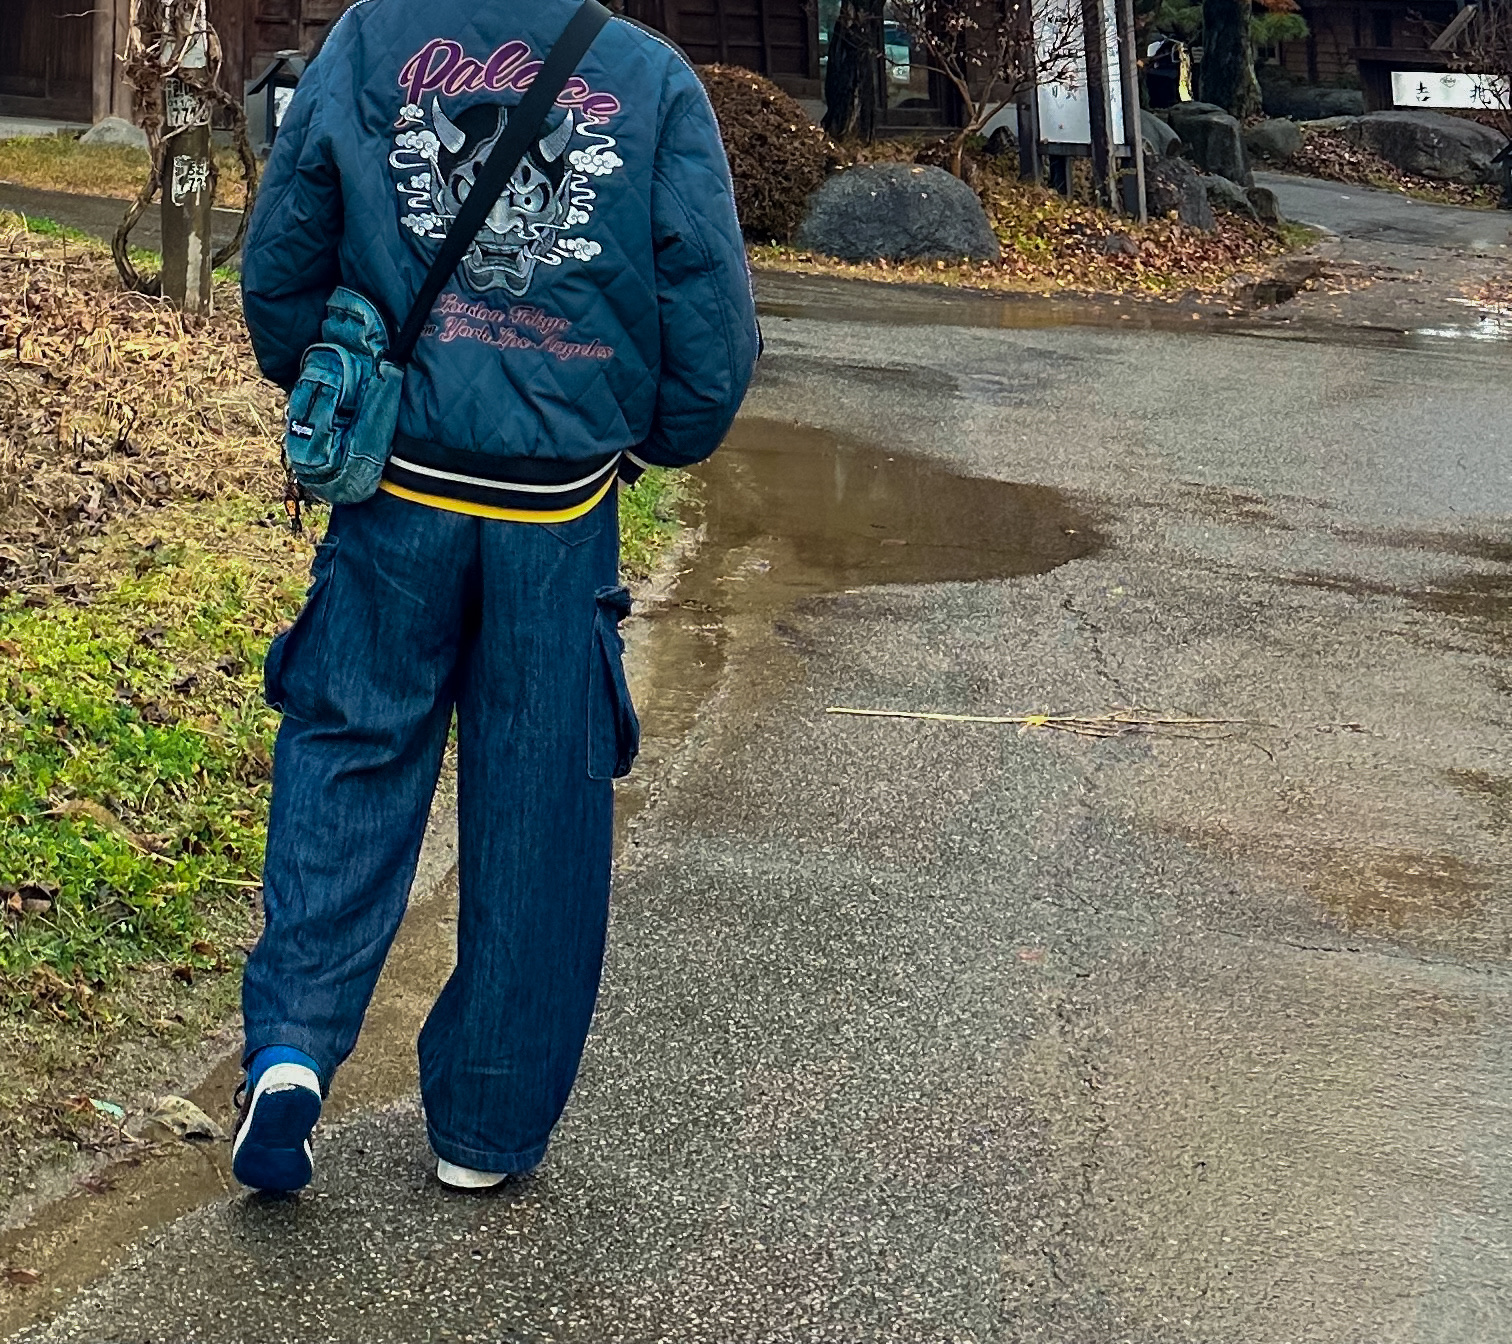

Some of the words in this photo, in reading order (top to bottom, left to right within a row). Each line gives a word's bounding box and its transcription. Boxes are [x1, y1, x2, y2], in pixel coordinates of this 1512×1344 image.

[434, 293, 506, 323] London
[509, 305, 573, 335] Tokyo
[439, 316, 492, 343] York
[490, 326, 535, 351] Los
[535, 334, 615, 361] Angeles
